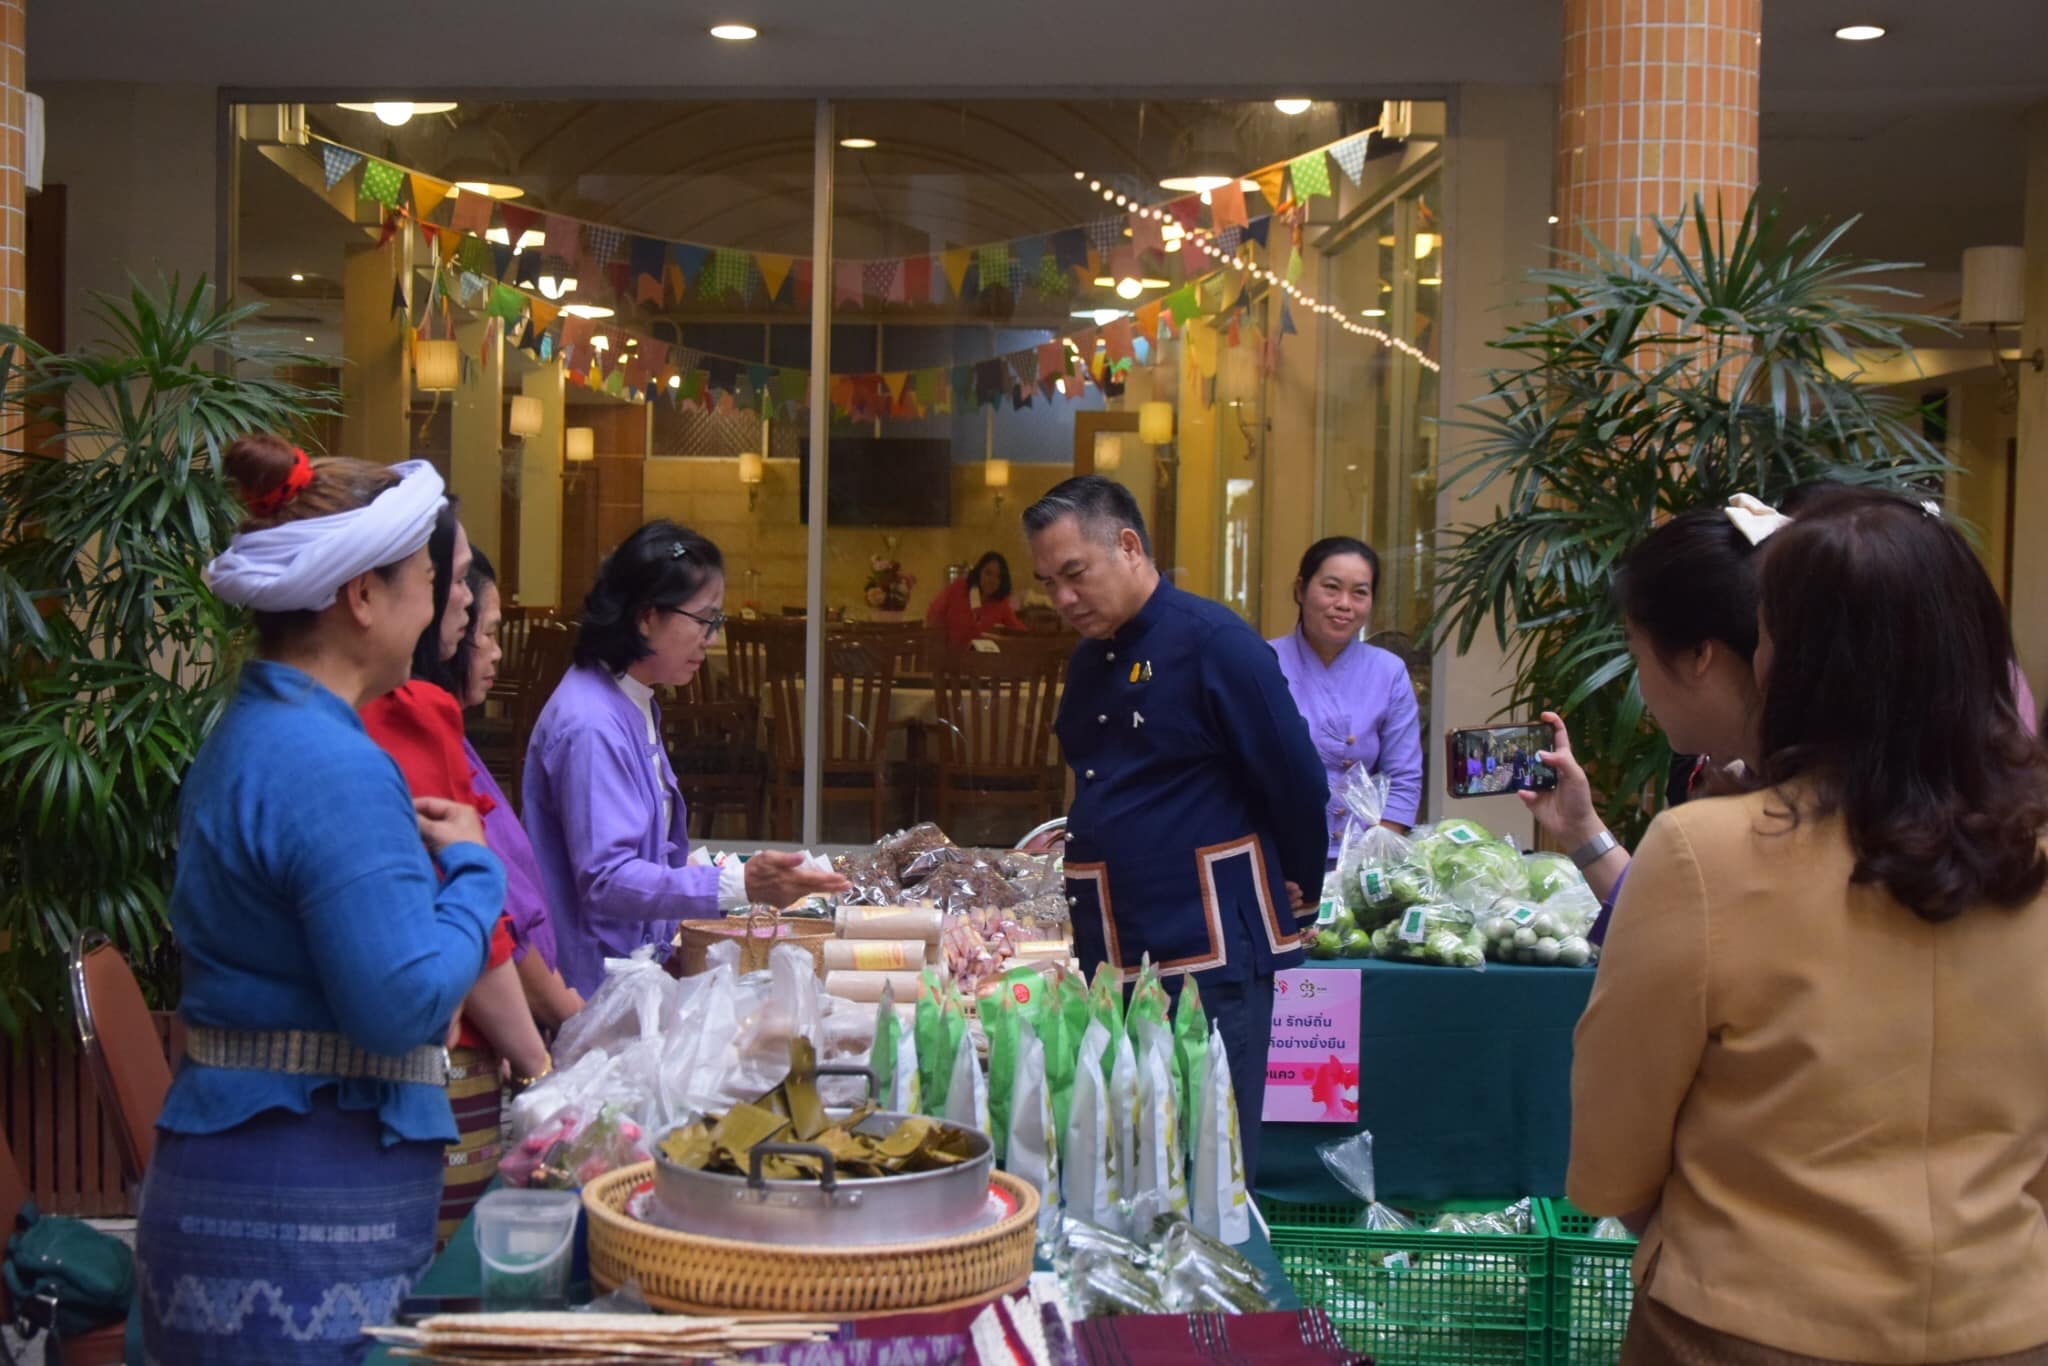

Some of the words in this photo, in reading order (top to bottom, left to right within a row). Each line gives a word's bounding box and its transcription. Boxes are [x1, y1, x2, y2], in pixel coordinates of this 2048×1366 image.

[1286, 1012, 1332, 1027] รักษ์ถิ่น
[1266, 1070, 1296, 1080] แคว
